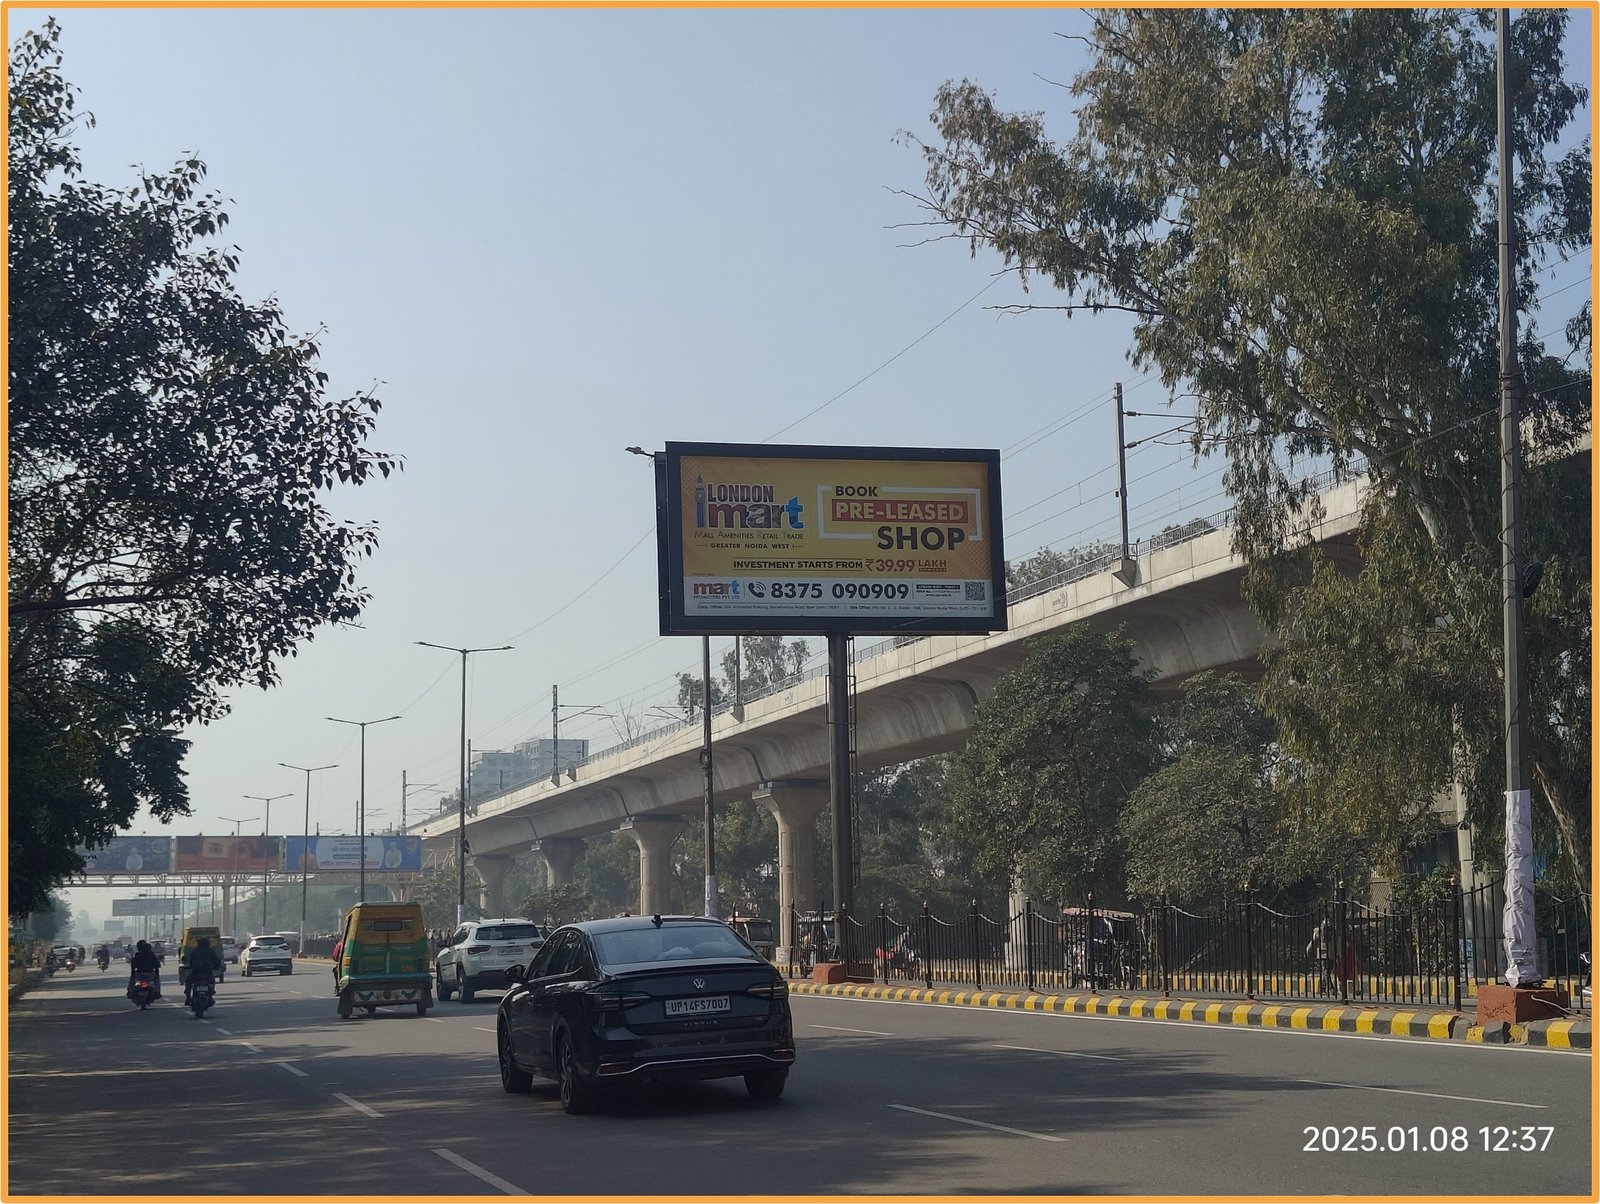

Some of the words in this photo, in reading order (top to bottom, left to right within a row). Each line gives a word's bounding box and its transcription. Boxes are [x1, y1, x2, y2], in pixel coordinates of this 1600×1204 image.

[707, 483, 774, 503] LONDON
[835, 486, 878, 497] BOOK
[708, 495, 805, 529] mart
[835, 501, 965, 521] PRE-LEASED
[877, 525, 965, 550] SHOP
[733, 560, 795, 569] INVESTMENT
[797, 560, 833, 569] STARTS
[835, 561, 863, 569] FROM
[918, 559, 947, 568] LAKH
[693, 579, 740, 595] mart
[771, 582, 823, 599] 8375
[832, 583, 909, 599] 090909
[671, 998, 729, 1012] UP14FS7007
